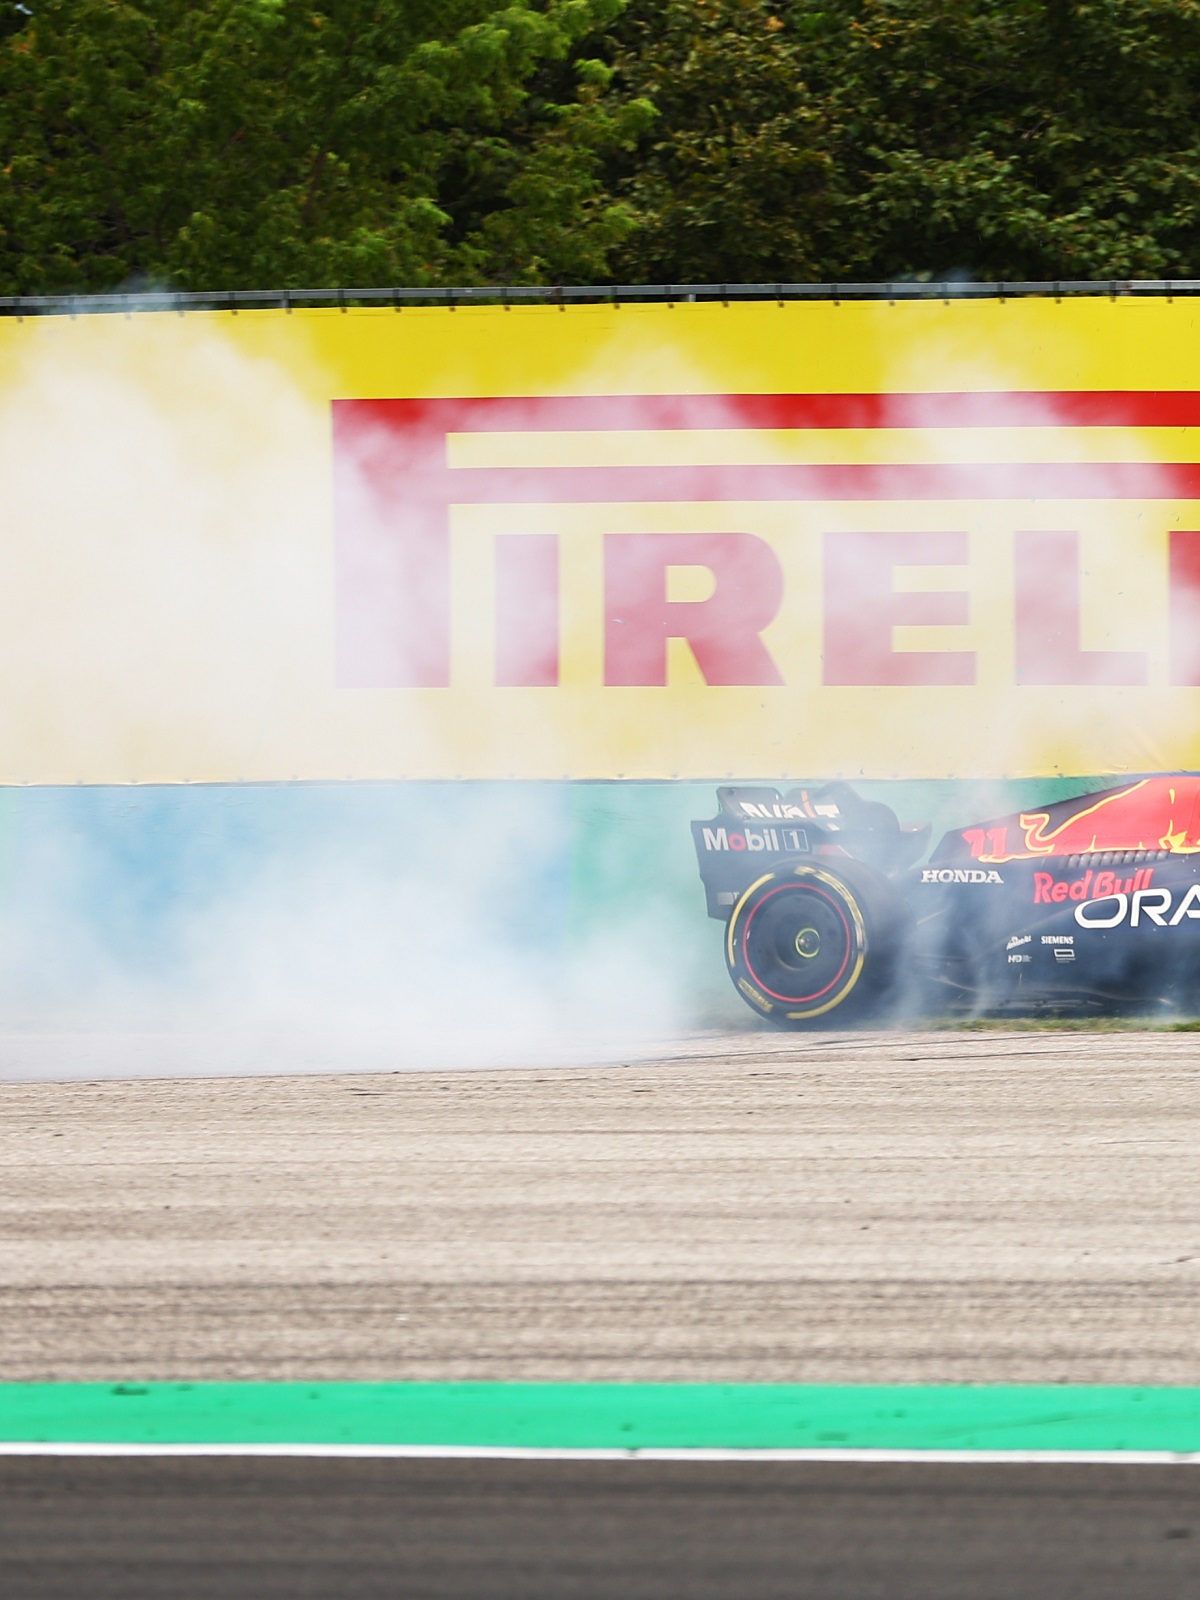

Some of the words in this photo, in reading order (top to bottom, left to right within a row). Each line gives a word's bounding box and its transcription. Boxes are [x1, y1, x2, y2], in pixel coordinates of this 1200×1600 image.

[702, 828, 780, 851] Mobil
[962, 828, 1008, 857] 11
[921, 869, 1004, 884] HONDA
[1033, 870, 1093, 904] Red
[1092, 868, 1154, 898] Bull
[1041, 935, 1074, 945] SIEMENS
